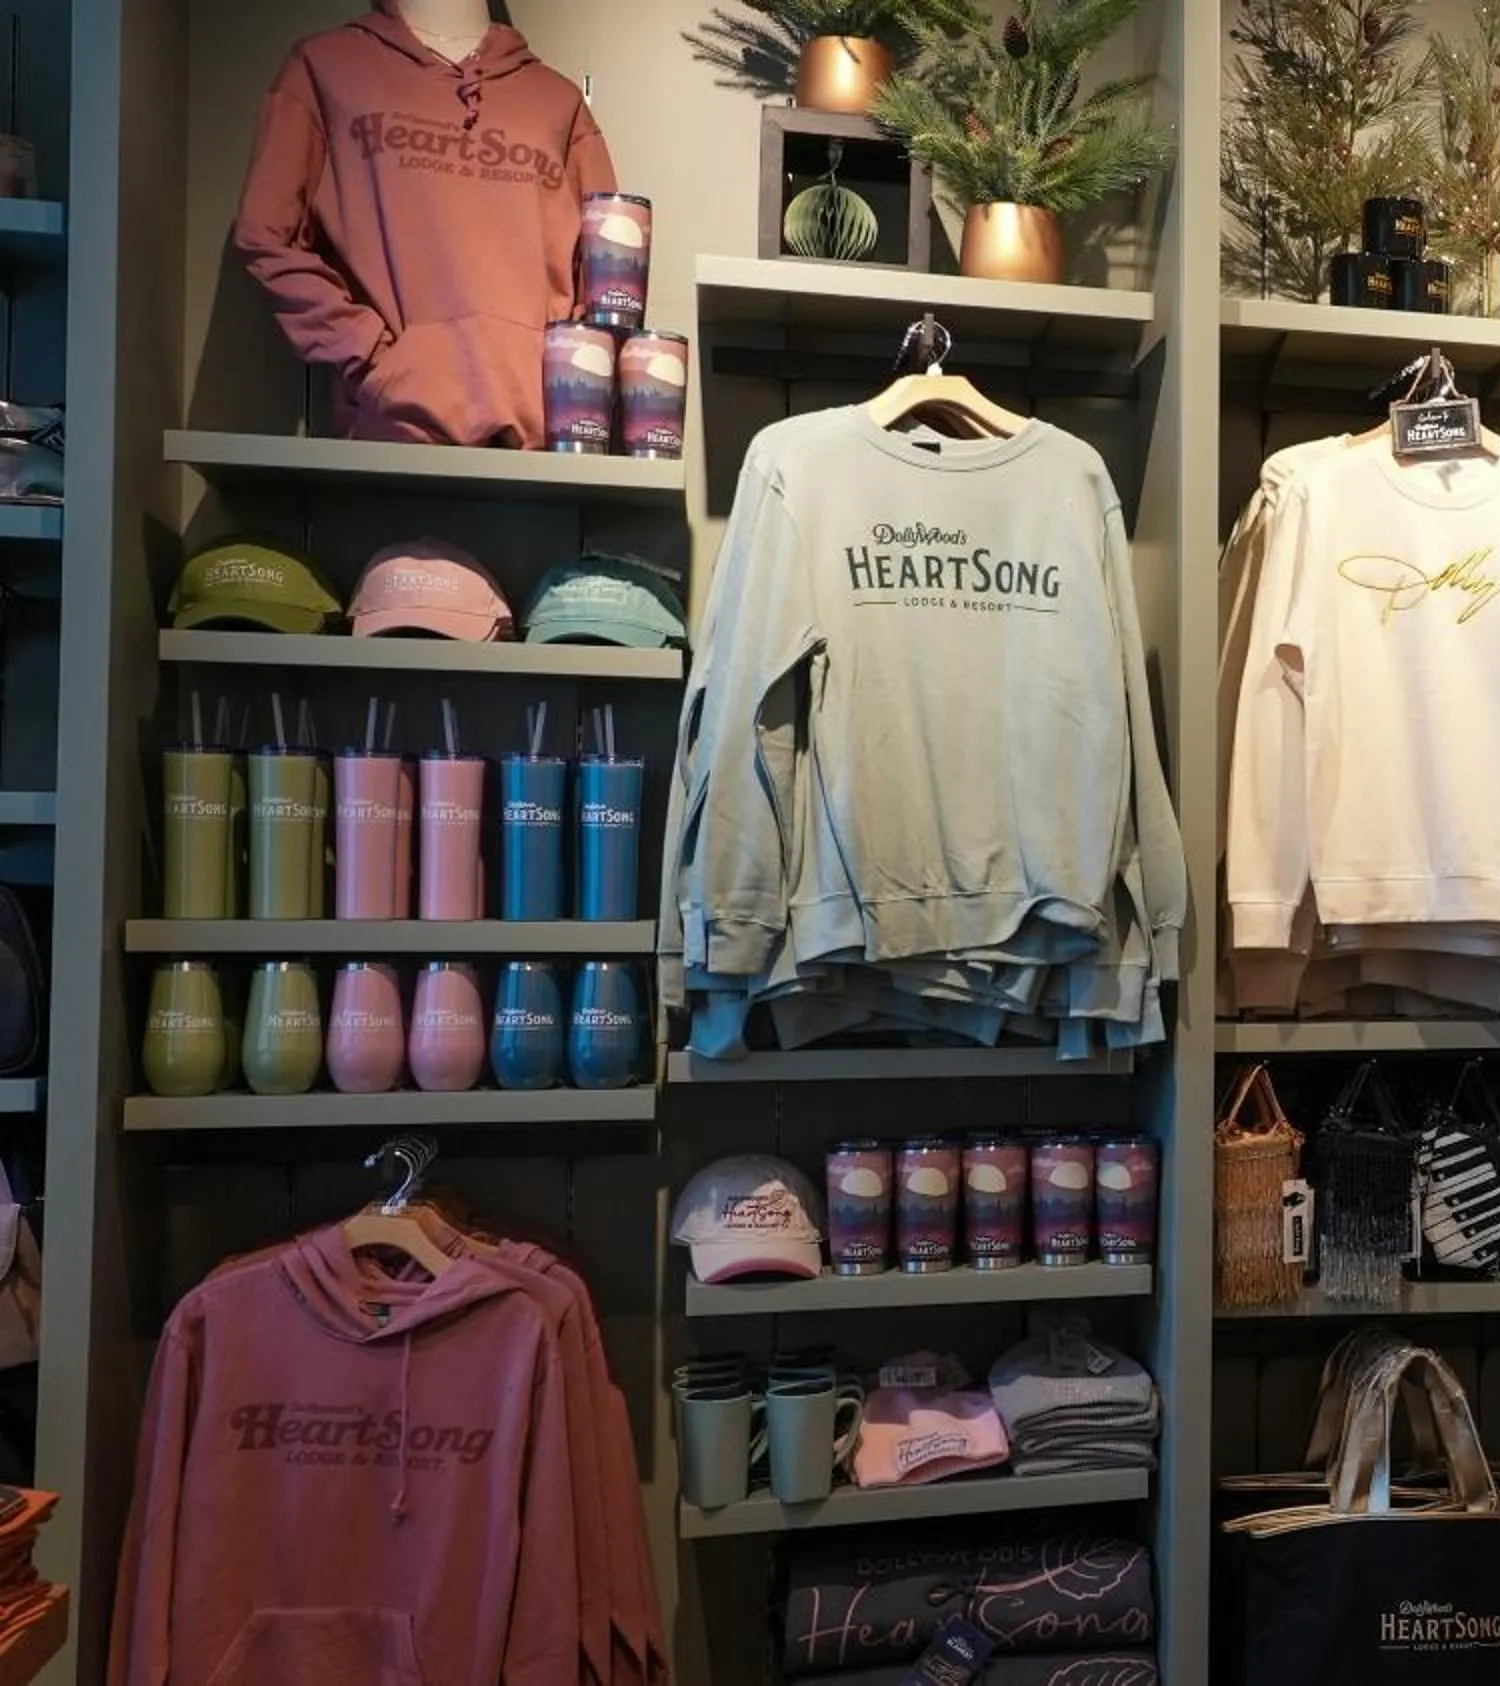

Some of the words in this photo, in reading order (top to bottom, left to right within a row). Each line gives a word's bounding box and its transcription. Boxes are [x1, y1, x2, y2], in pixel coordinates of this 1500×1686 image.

[351, 111, 564, 191] HeartSong
[845, 545, 1061, 599] HEARTSONG
[229, 1403, 495, 1464] HeartSong
